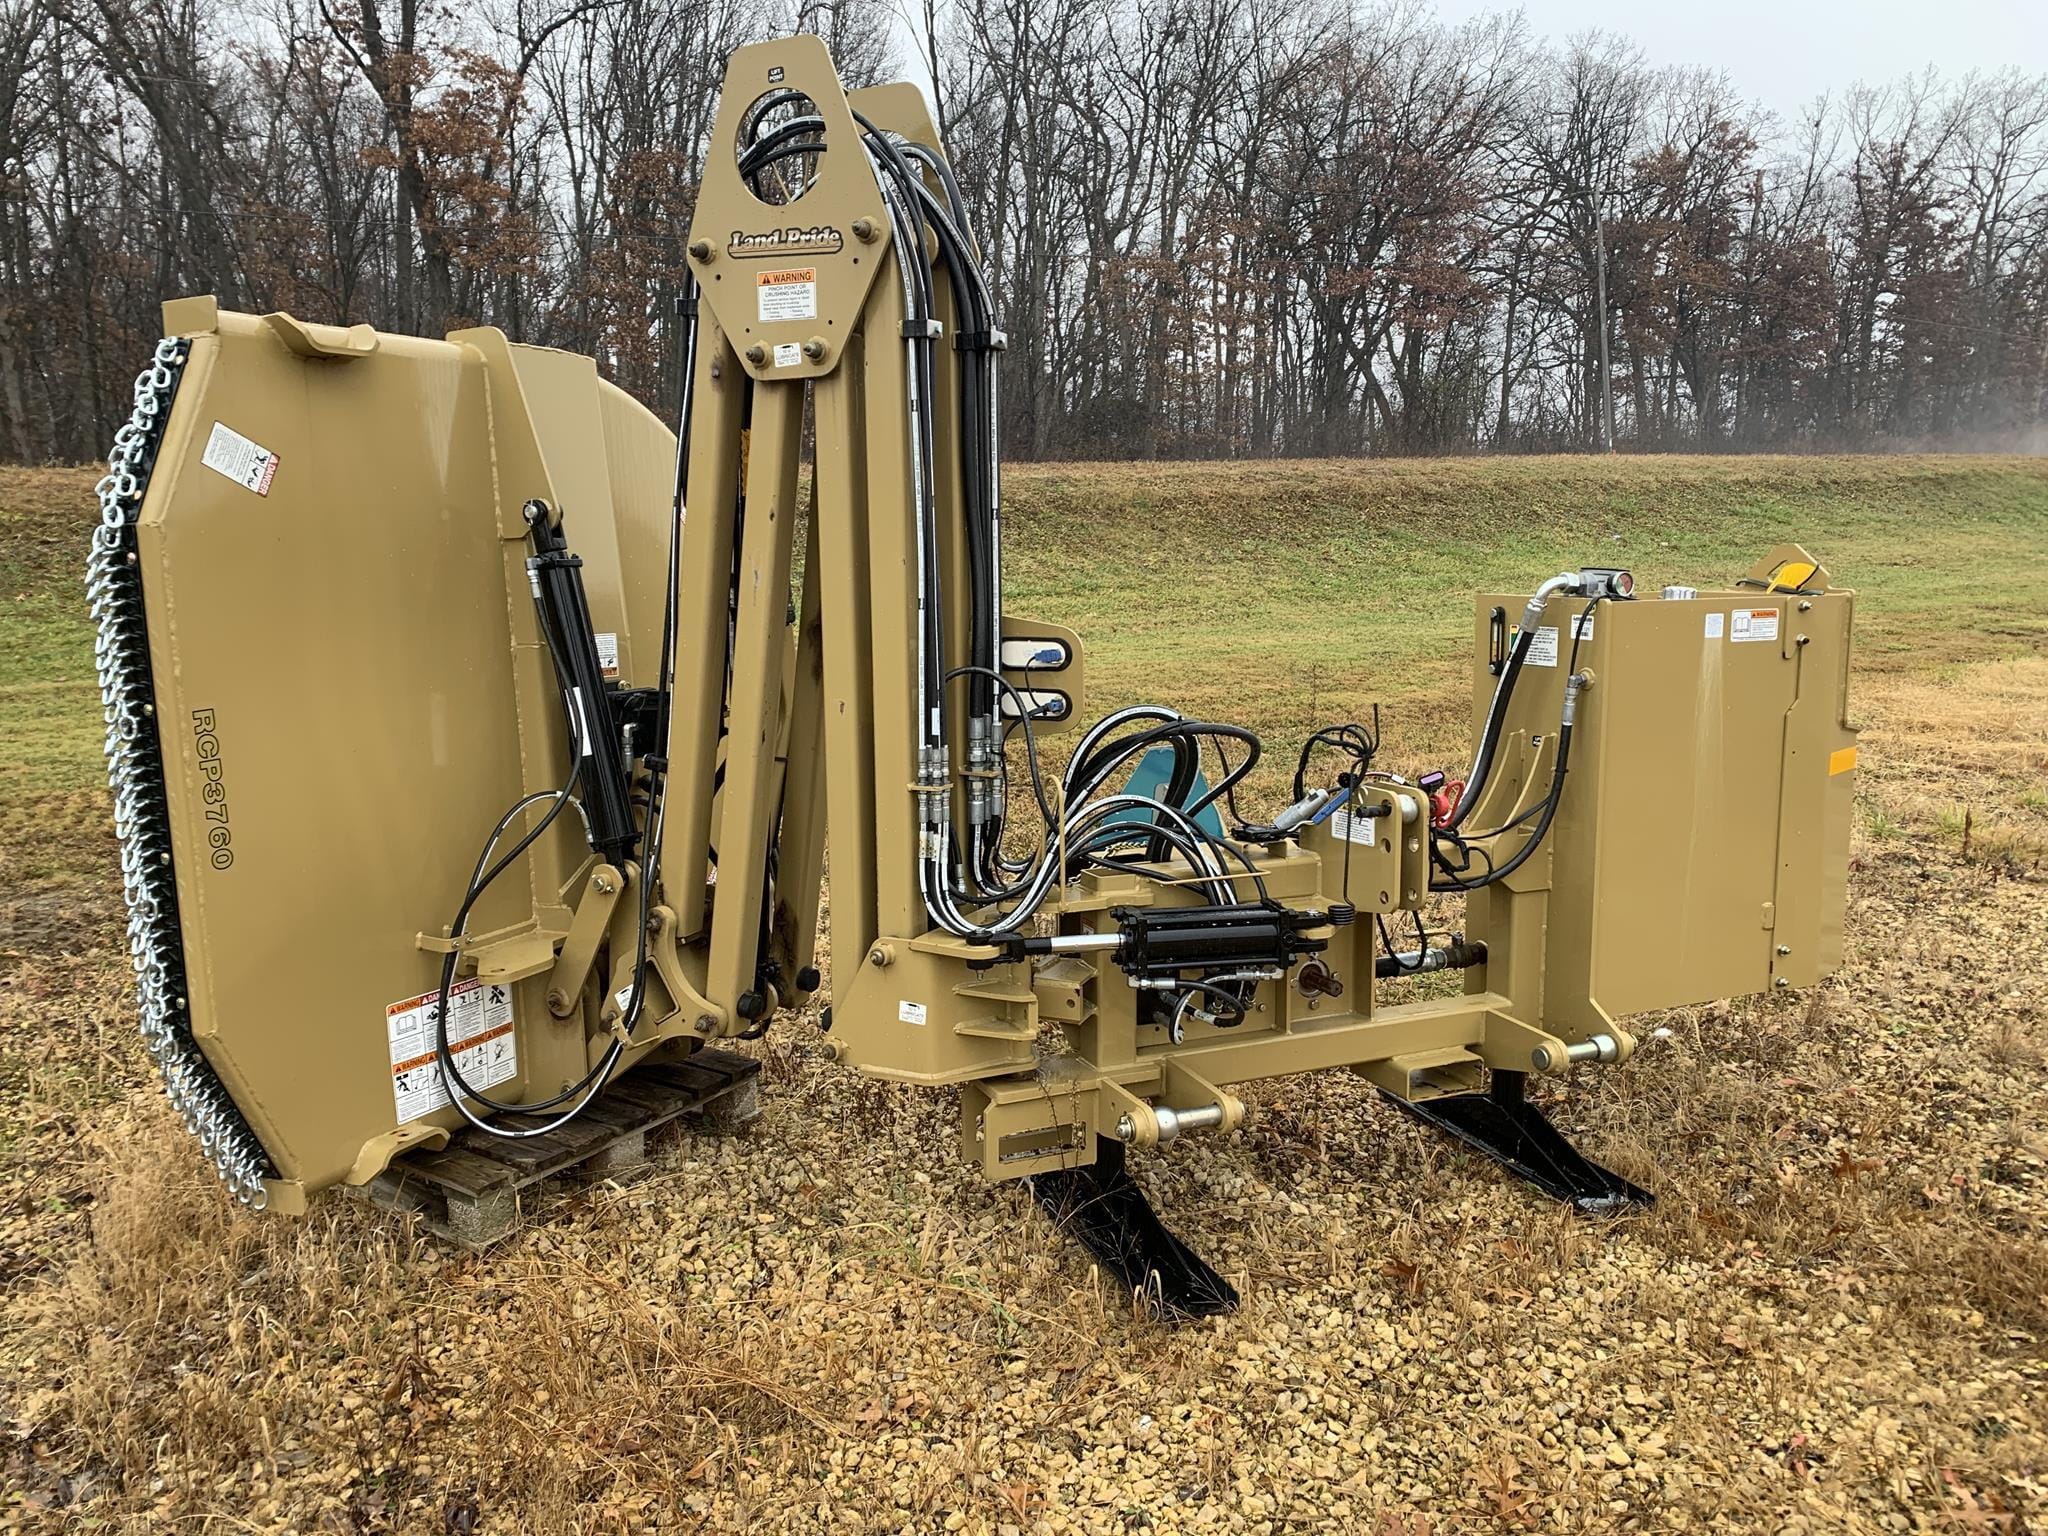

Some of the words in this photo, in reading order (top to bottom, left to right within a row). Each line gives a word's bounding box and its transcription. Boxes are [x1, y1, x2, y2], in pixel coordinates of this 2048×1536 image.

[730, 229, 781, 251] Land
[786, 227, 841, 248] Pride
[773, 271, 811, 283] WARNING
[258, 463, 277, 495] DANGER
[192, 708, 234, 871] RCP3760
